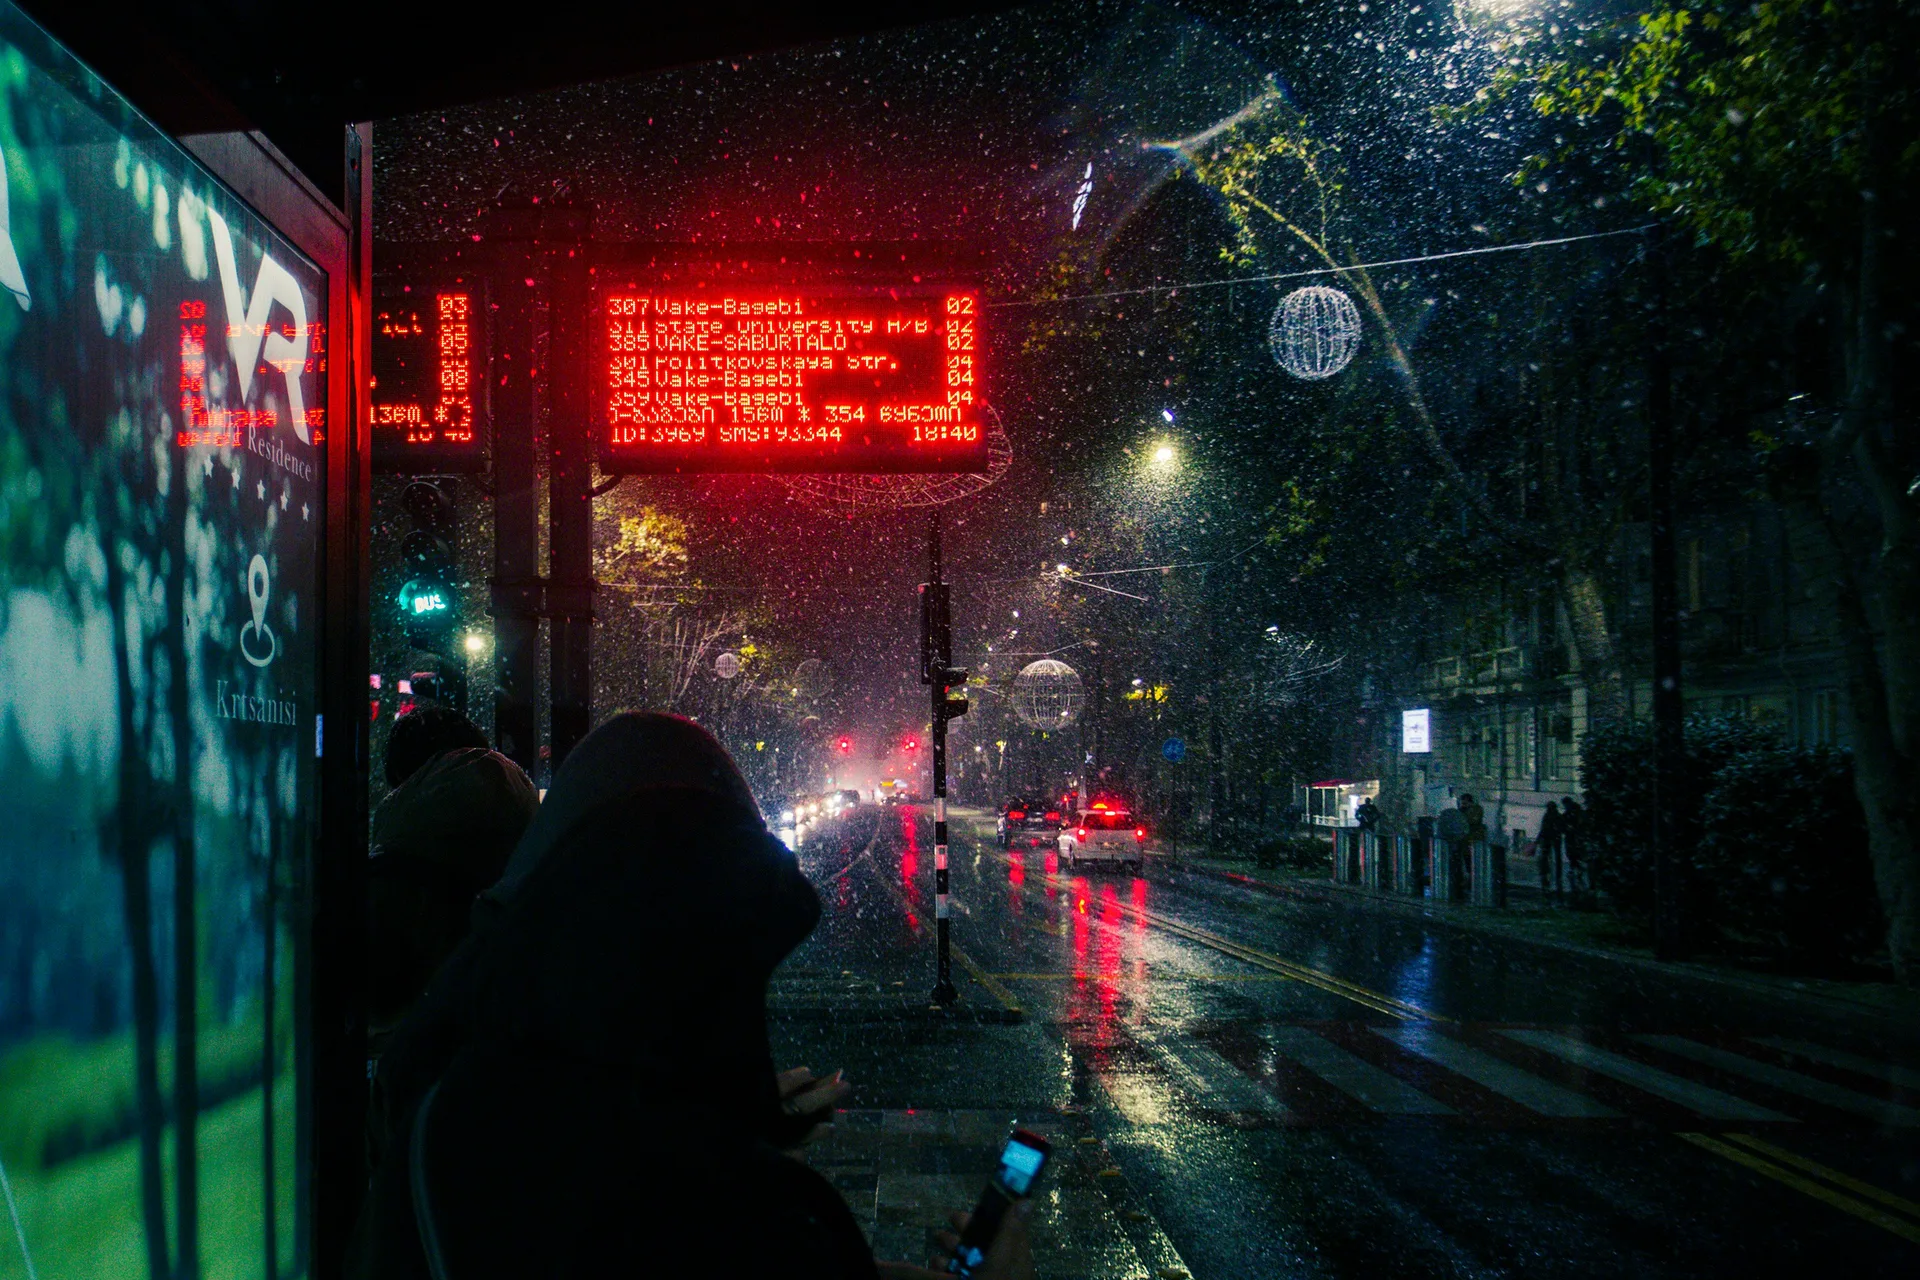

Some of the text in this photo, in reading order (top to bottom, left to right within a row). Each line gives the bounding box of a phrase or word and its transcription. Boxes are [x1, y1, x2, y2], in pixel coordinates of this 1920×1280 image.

[609, 296, 973, 315] 307 Vake-Bagebi 02
[609, 334, 974, 351] 385 VAKE-SABURTALO 02
[609, 370, 974, 388] 345 Vake-Bagebi 04
[824, 405, 866, 423] 354
[247, 423, 313, 482] Residence
[215, 679, 297, 726] Krtsanisi
